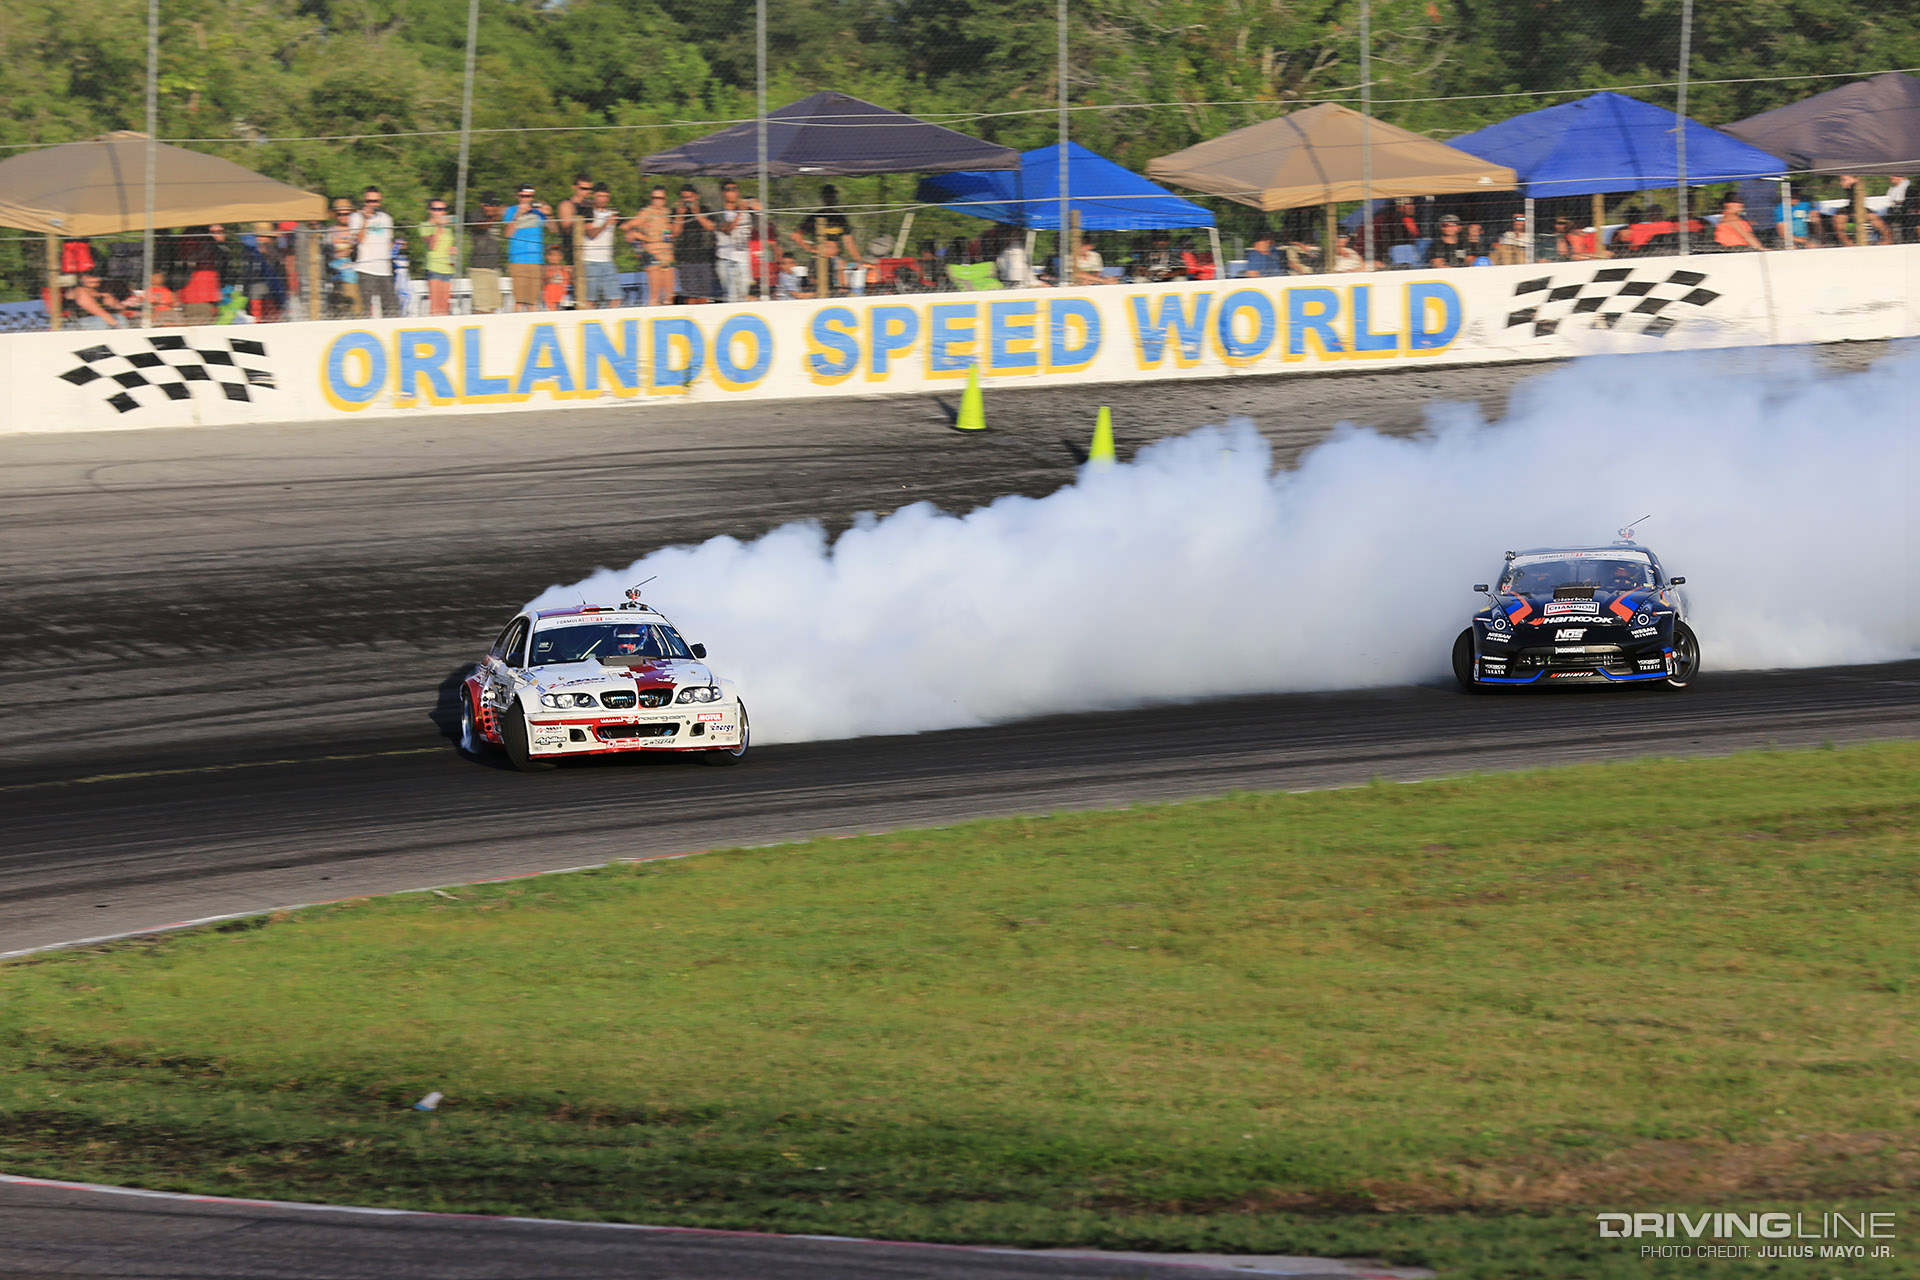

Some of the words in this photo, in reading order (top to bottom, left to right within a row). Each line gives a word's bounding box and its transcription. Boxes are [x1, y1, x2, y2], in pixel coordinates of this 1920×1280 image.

[320, 313, 773, 412] ORLANDO
[805, 296, 1102, 386] SPEED
[1126, 279, 1463, 371] WORLD
[1555, 628, 1588, 639] NOS
